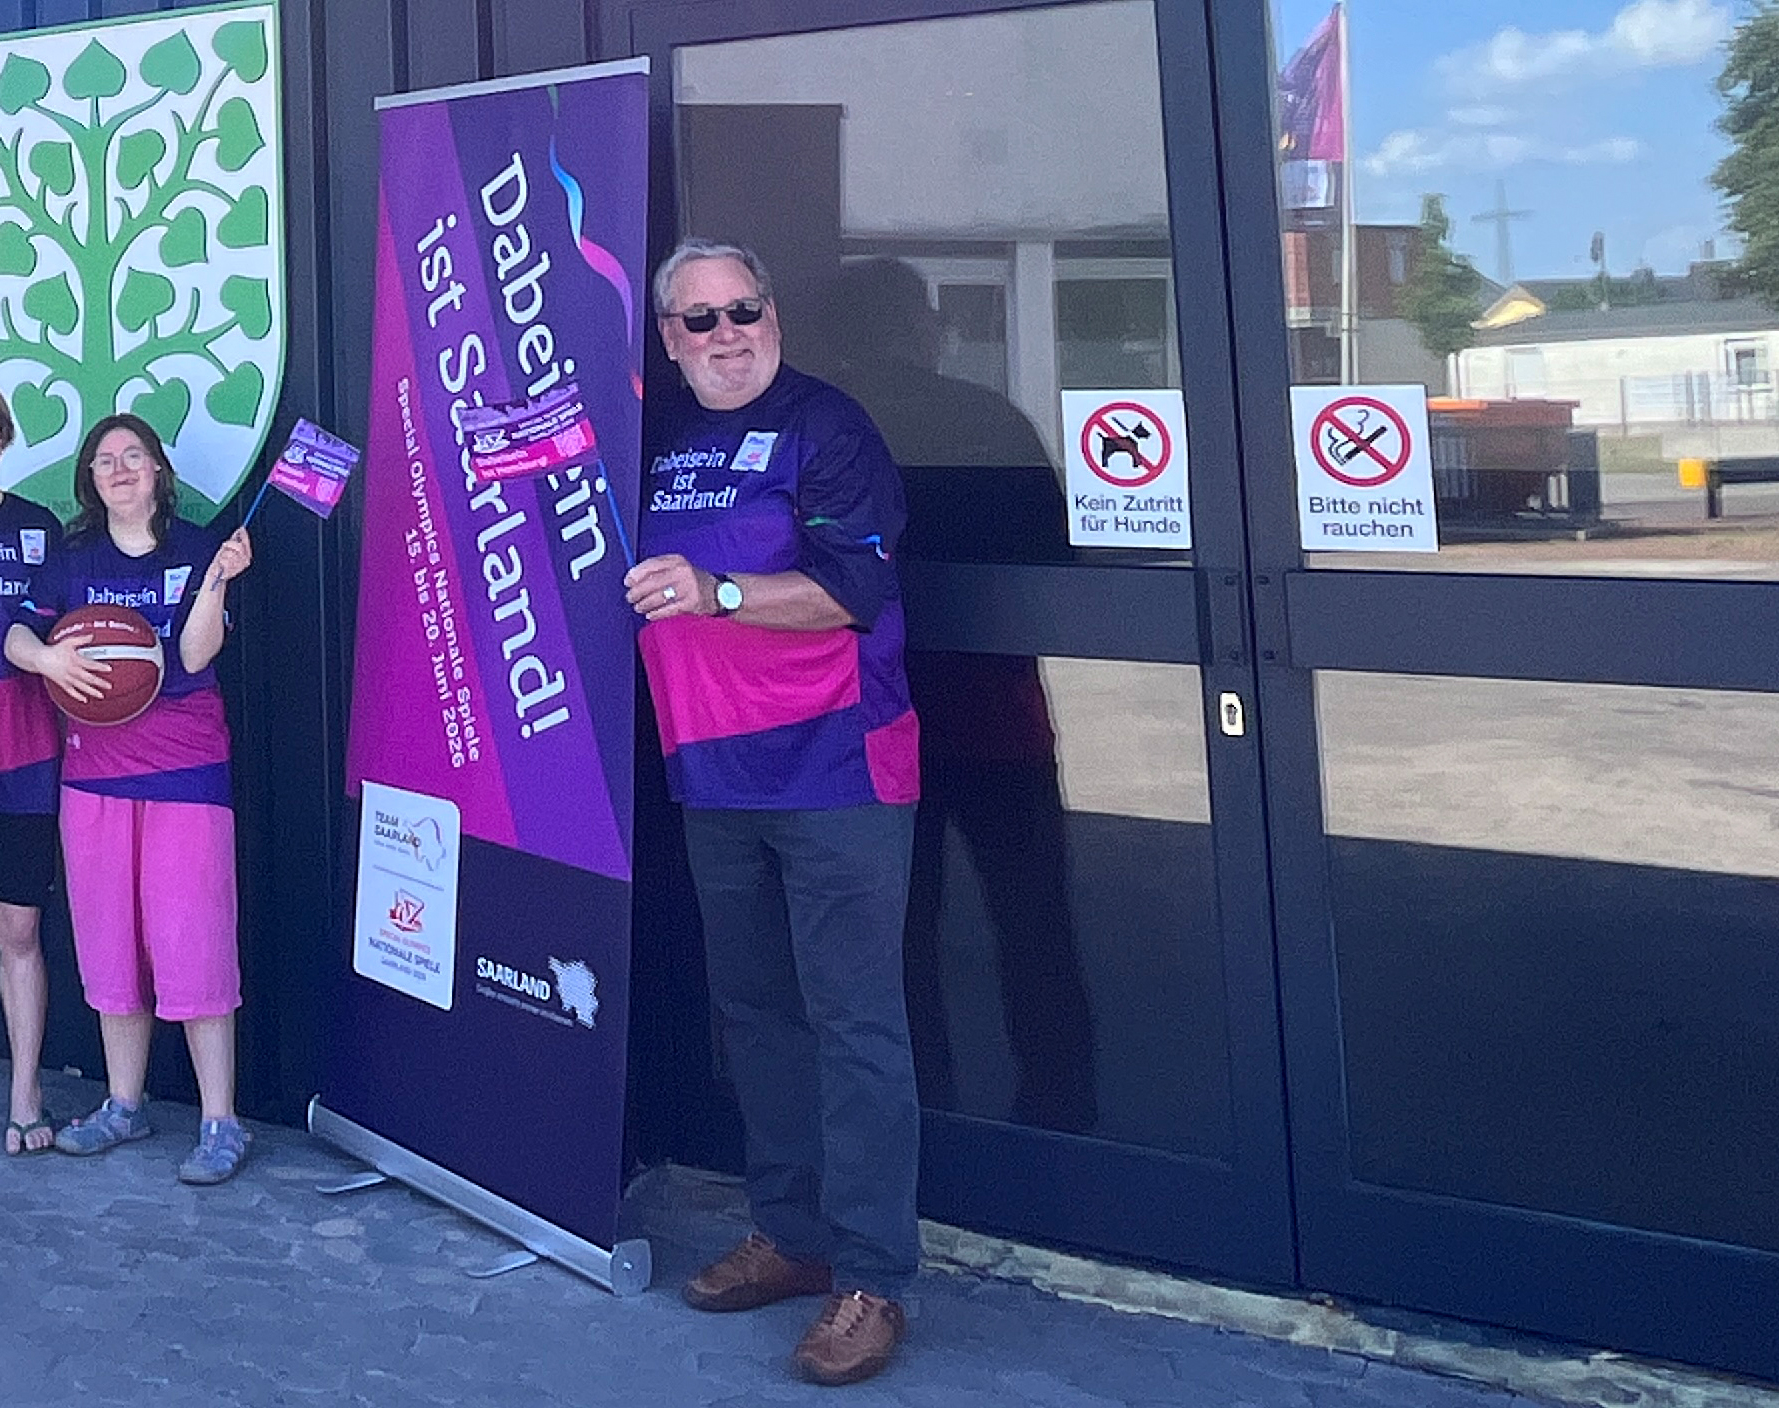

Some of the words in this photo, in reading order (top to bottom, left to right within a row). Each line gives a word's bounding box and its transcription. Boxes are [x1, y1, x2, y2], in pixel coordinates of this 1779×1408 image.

[417, 214, 467, 328] ist
[481, 152, 607, 581] Dabeiin
[672, 469, 696, 489] ist
[650, 486, 737, 511] Saarland!
[1075, 495, 1117, 512] Kein
[1123, 495, 1183, 513] Zutritt
[1309, 497, 1361, 514] Bitte
[1368, 498, 1423, 516] nicht
[1081, 516, 1107, 532] für
[1114, 516, 1181, 534] Hunde
[1323, 521, 1413, 538] rauchen
[405, 529, 422, 564] 15.
[397, 378, 421, 458] Special
[410, 461, 441, 566] Olympics
[434, 569, 464, 681] Nationale
[457, 687, 481, 762] Spiele
[414, 567, 431, 604] bis
[422, 609, 440, 647] 20.
[432, 652, 453, 700] Juni
[442, 707, 465, 768] 2026
[476, 956, 551, 1002] SAARLAND
